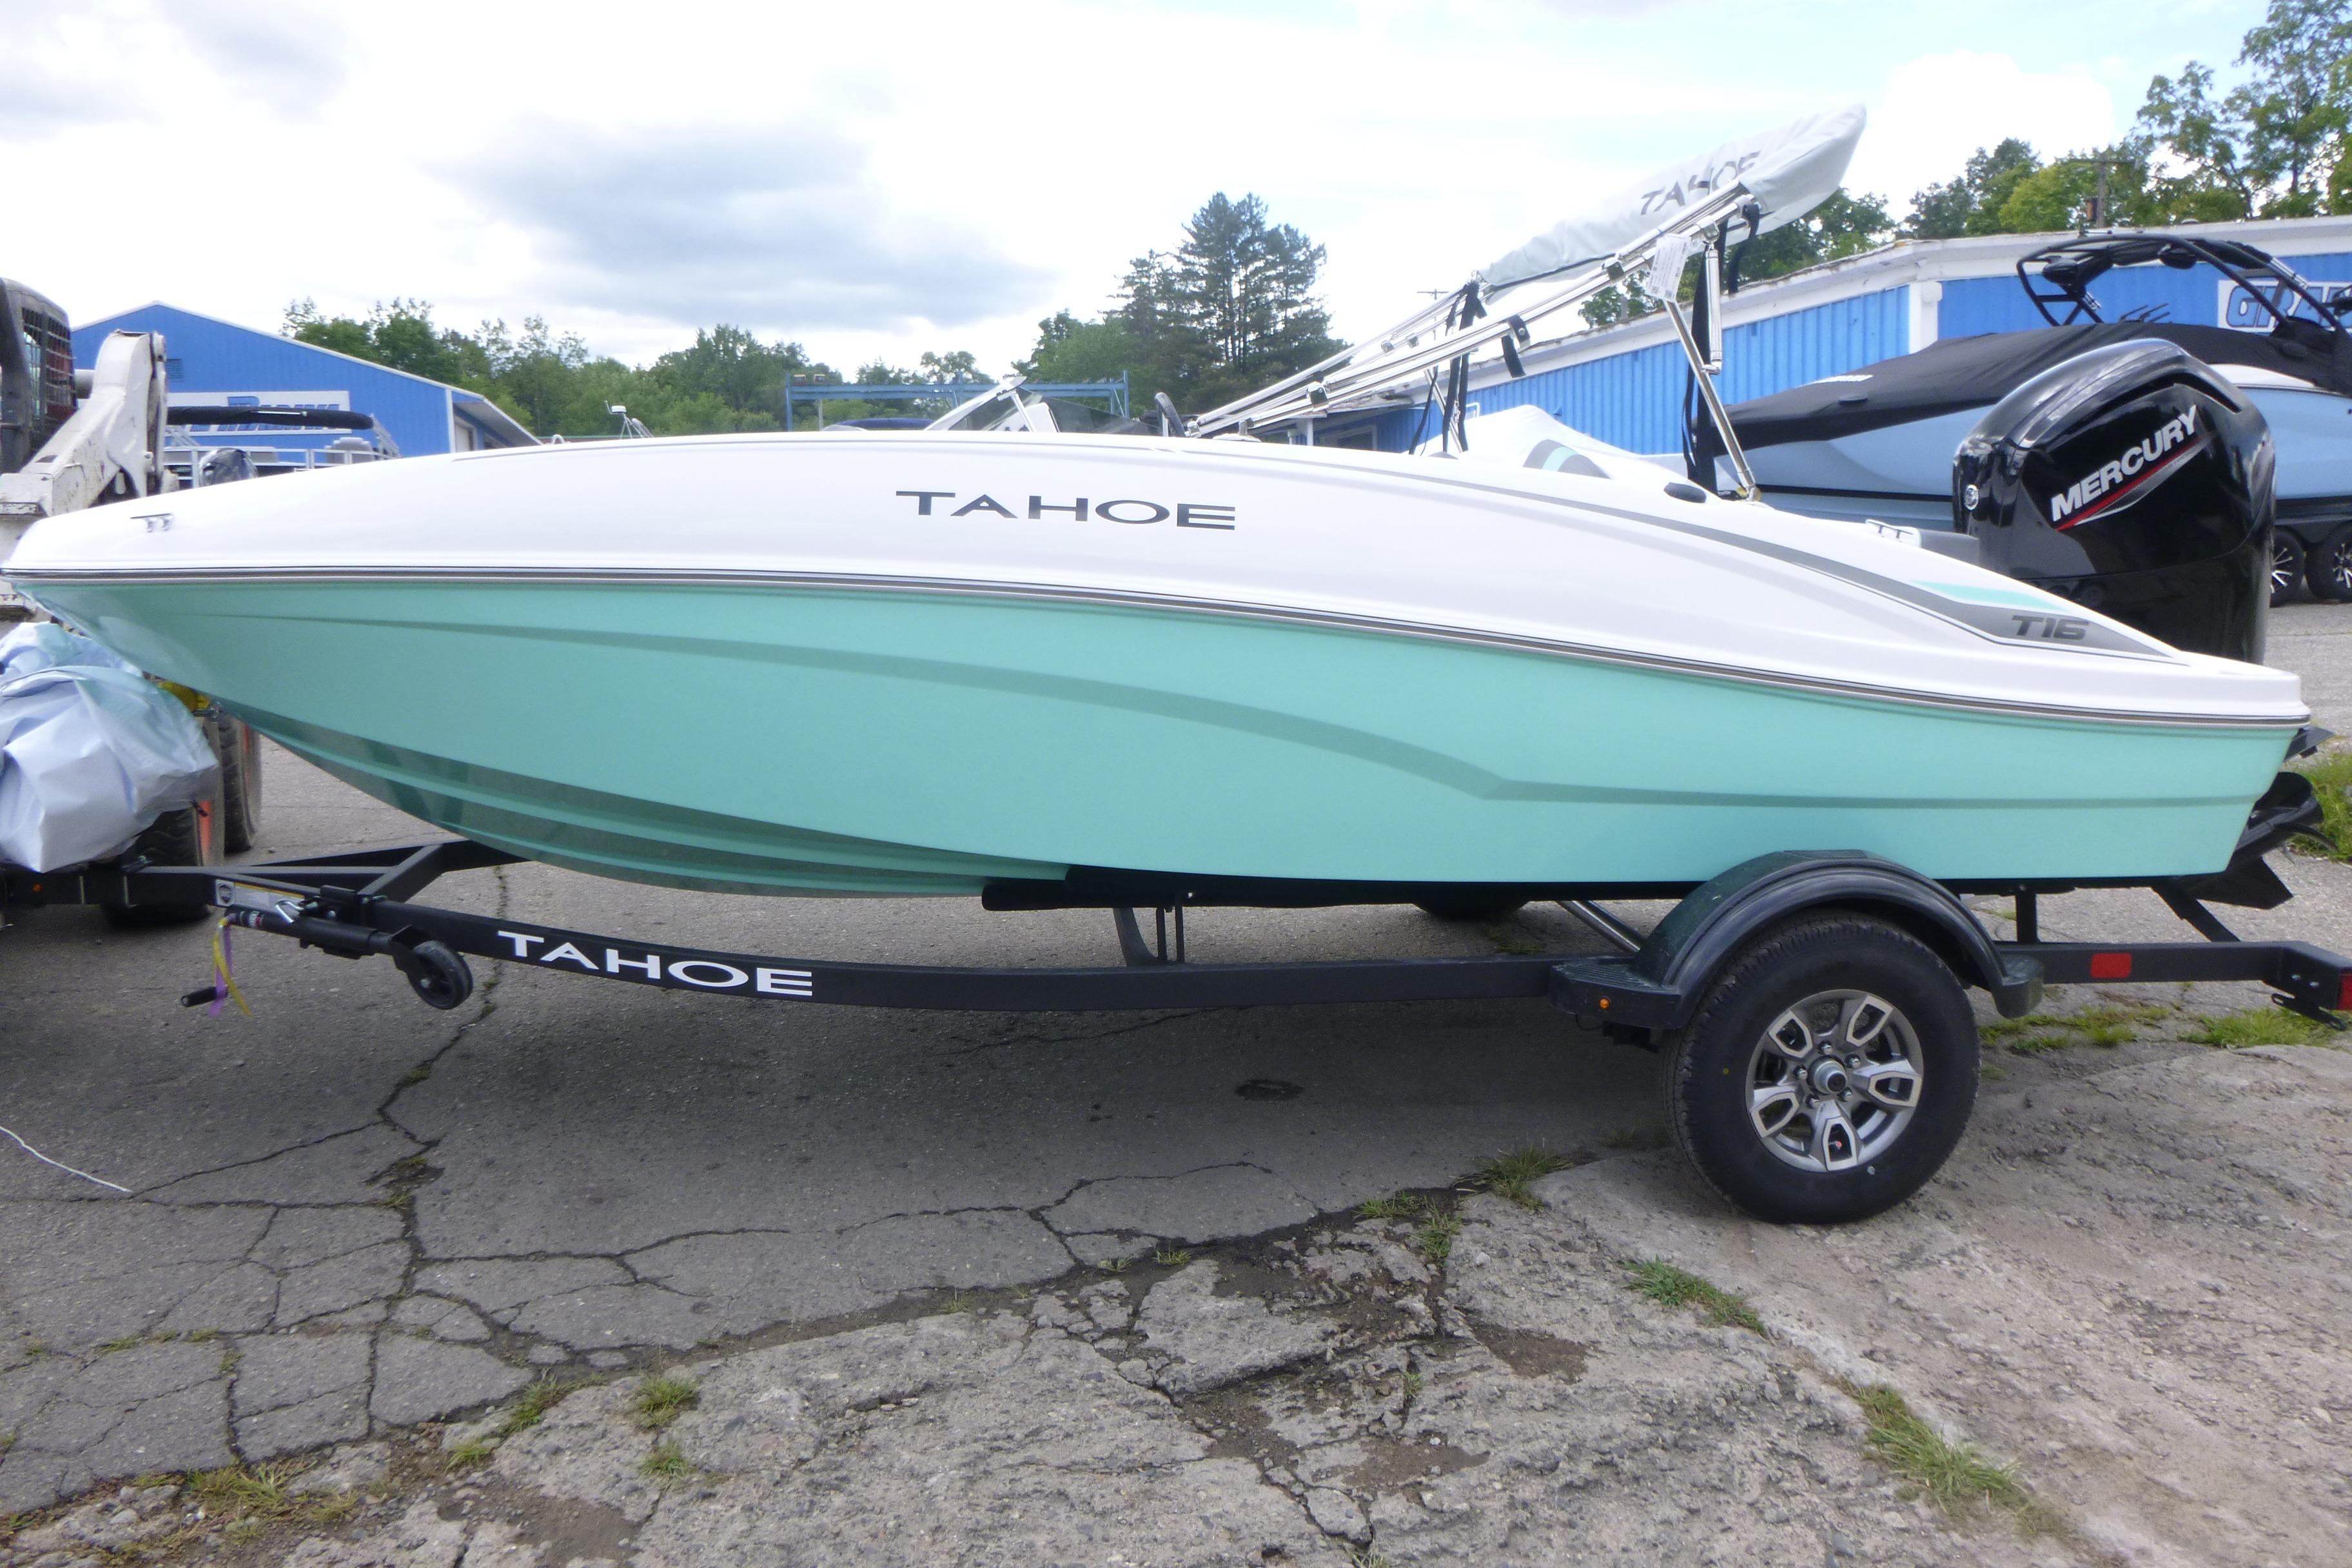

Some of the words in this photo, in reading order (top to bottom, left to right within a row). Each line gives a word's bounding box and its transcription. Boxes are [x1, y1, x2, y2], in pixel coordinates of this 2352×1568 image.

[2051, 404, 2197, 522] MERCURY
[896, 490, 1236, 531] TAHOE
[2012, 614, 2089, 640] T16
[497, 930, 813, 997] TAHOE
